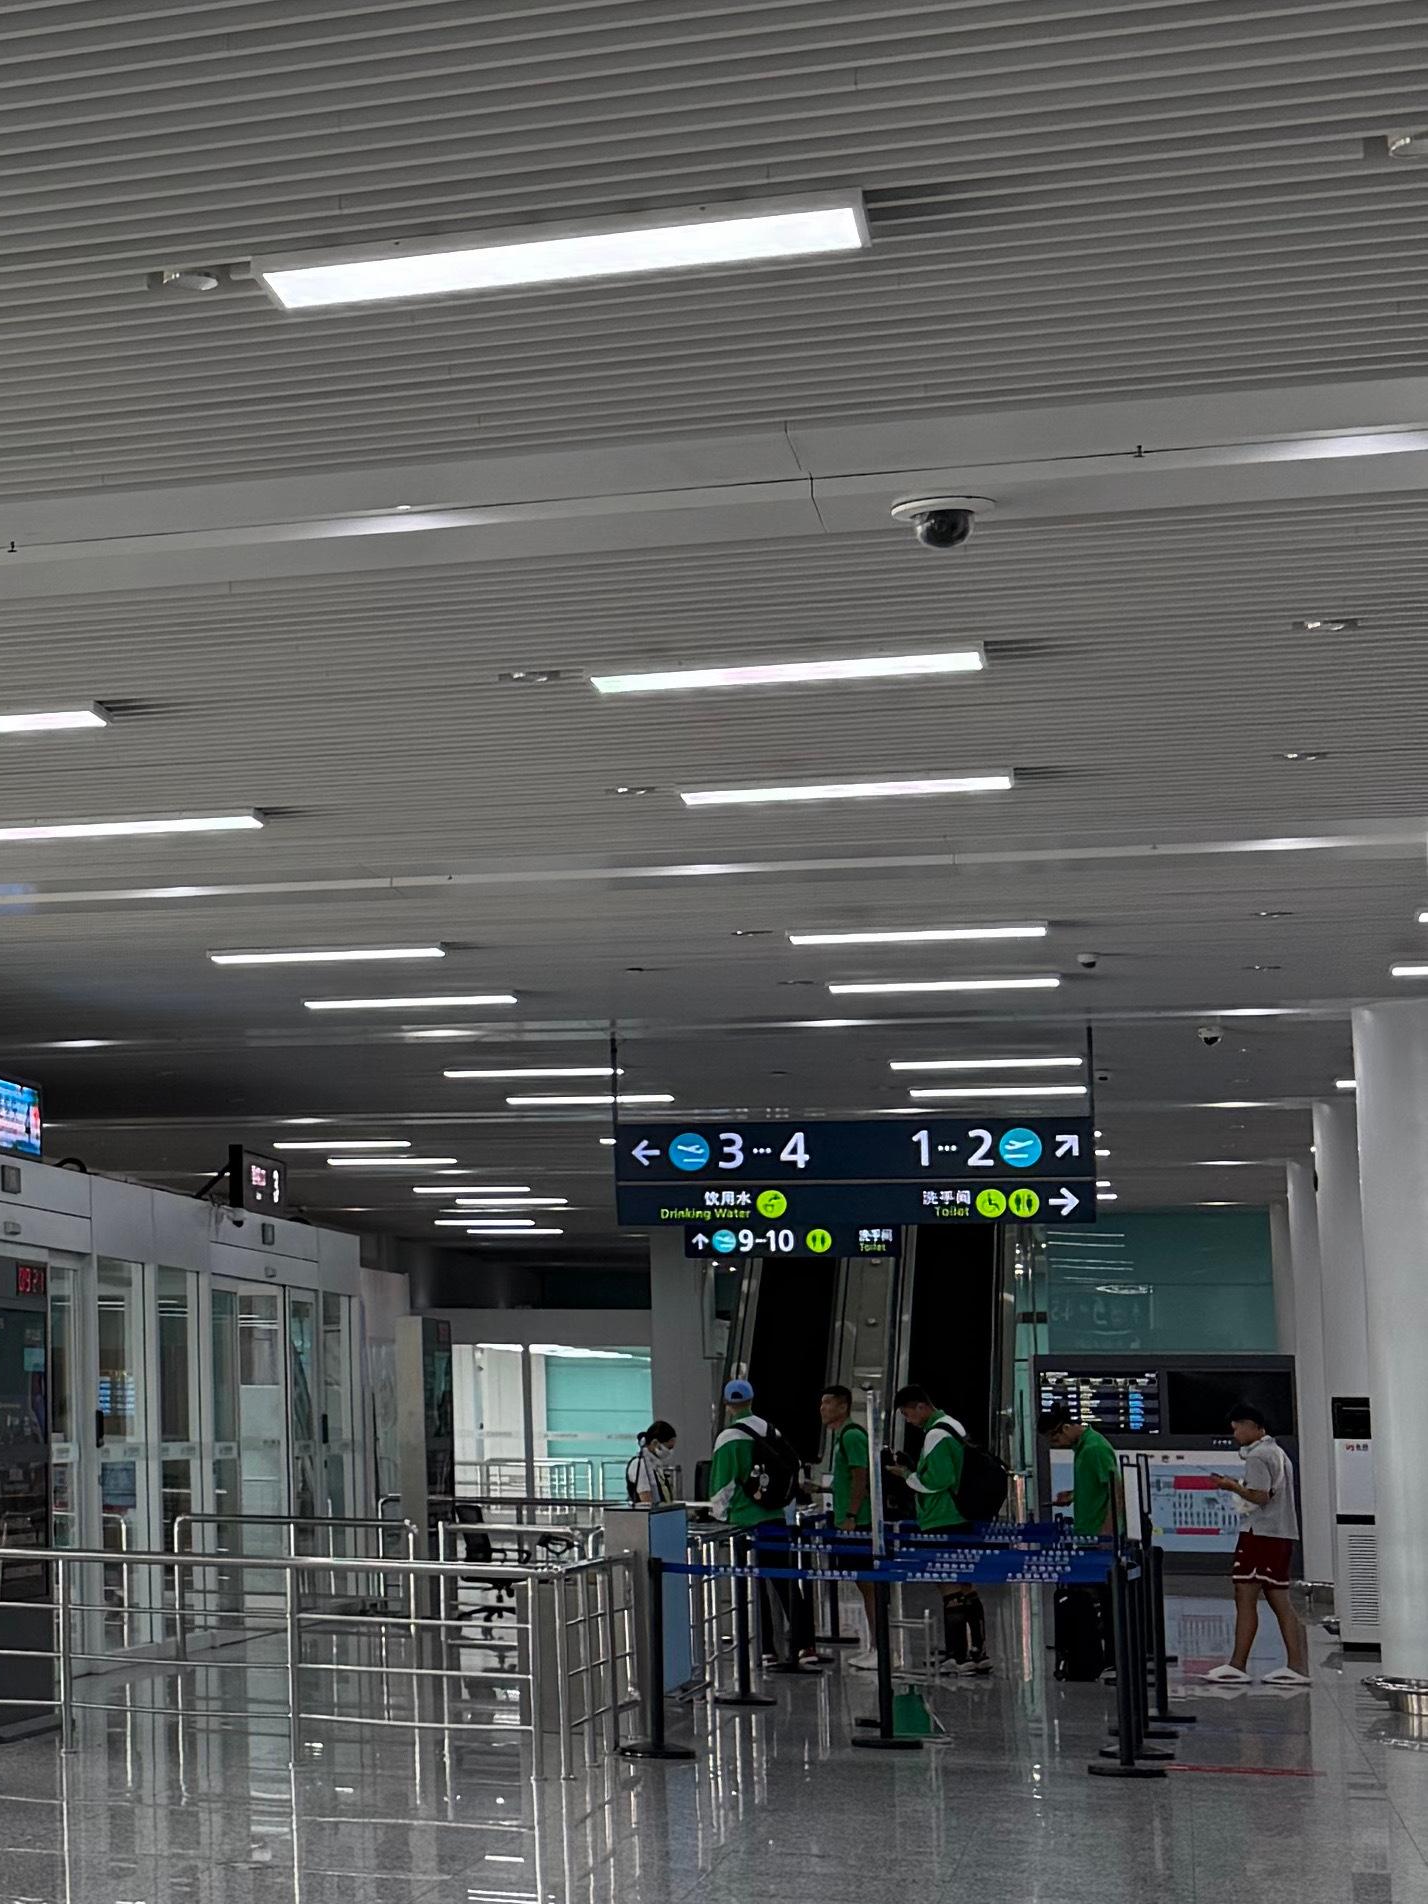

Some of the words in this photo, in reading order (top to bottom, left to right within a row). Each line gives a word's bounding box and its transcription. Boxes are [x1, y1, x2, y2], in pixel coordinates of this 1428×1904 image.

[704, 1191, 751, 1206] 饮用水
[922, 1190, 971, 1205] 洗手间
[660, 1207, 713, 1221] Drinking
[715, 1207, 751, 1219] Water
[935, 1206, 970, 1217] Toilet
[739, 1229, 795, 1253] 9-10
